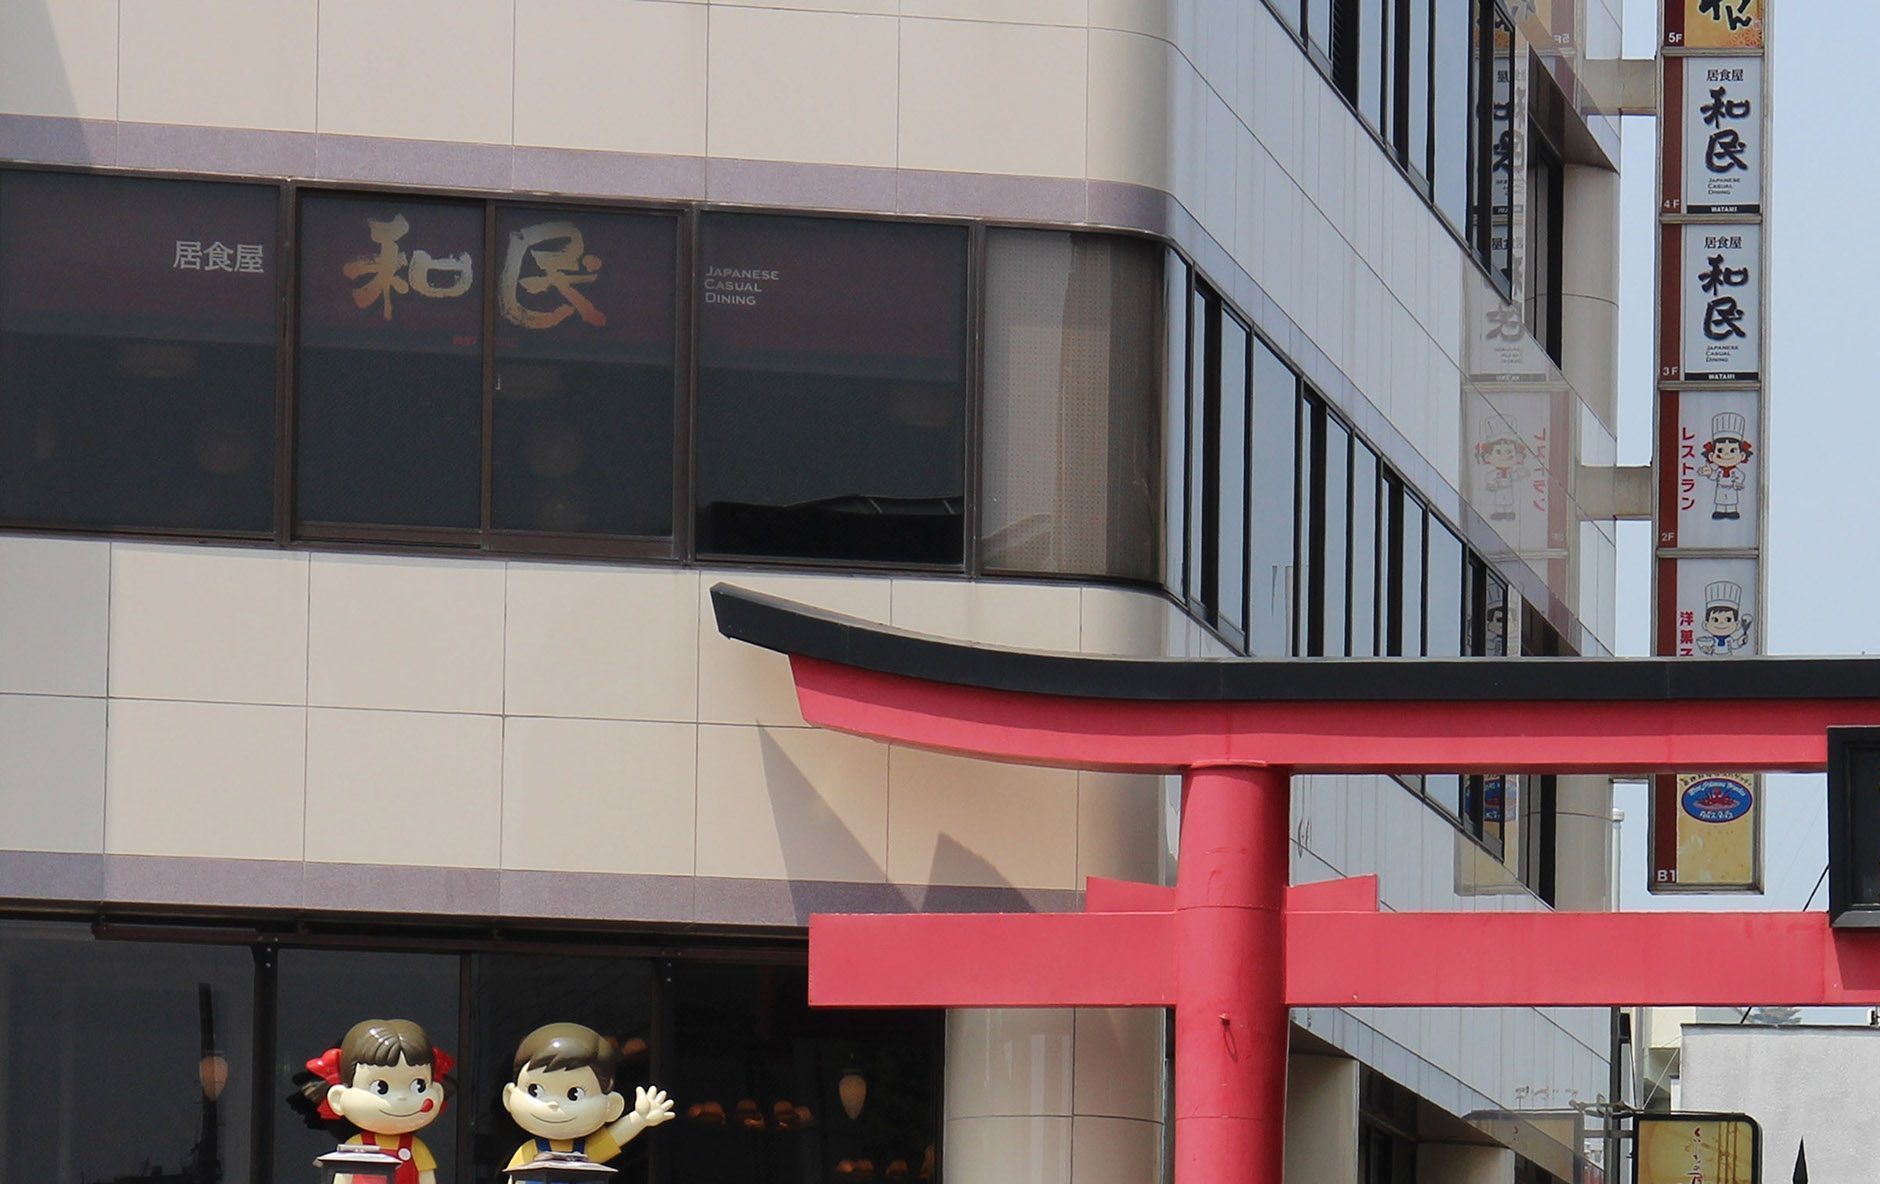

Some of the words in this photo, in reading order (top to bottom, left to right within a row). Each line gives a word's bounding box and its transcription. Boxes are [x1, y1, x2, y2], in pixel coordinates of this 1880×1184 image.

[1669, 32, 1682, 43] 5F
[1706, 69, 1744, 82] 居食屋
[1700, 86, 1751, 174] 和民
[1704, 236, 1742, 249] 居食屋
[173, 240, 265, 273] 居食屋
[342, 211, 607, 330] 和民
[706, 265, 780, 281] JAPANESE
[704, 278, 763, 293] CASUAL
[705, 291, 756, 306] DINING
[1698, 254, 1749, 341] 和民
[1681, 427, 1695, 511] レストラン
[1661, 532, 1675, 542] 2F
[1657, 869, 1676, 882] B1
